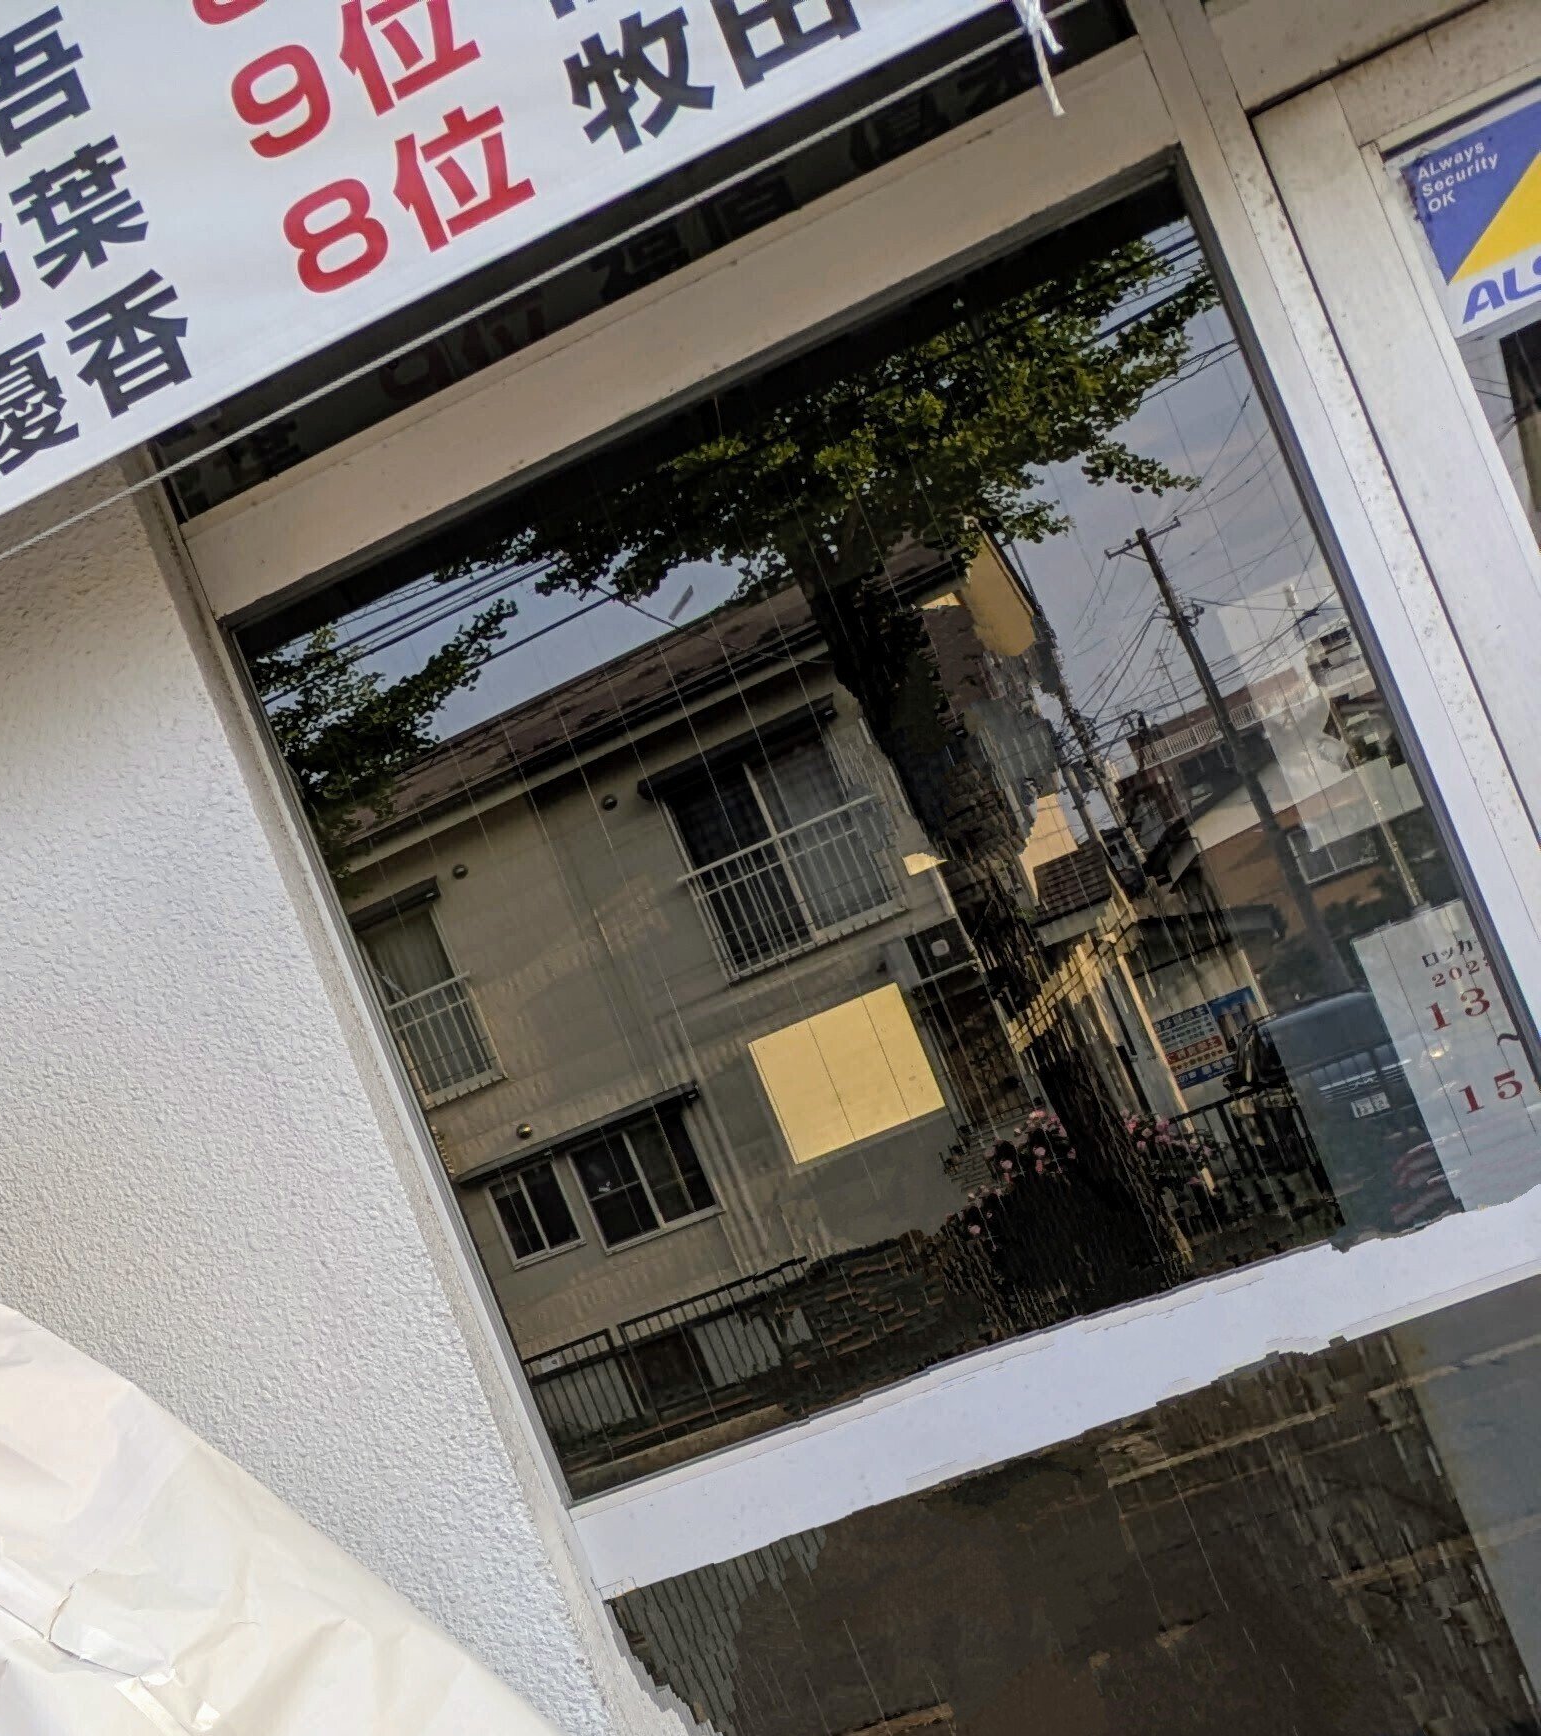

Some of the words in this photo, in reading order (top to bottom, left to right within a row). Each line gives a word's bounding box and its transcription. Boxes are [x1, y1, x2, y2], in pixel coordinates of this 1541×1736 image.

[230, 0, 482, 158] 9位
[1422, 153, 1499, 198] Security
[283, 105, 536, 293] 8位
[1428, 190, 1456, 212] OK
[1421, 939, 1479, 969] ロッカ
